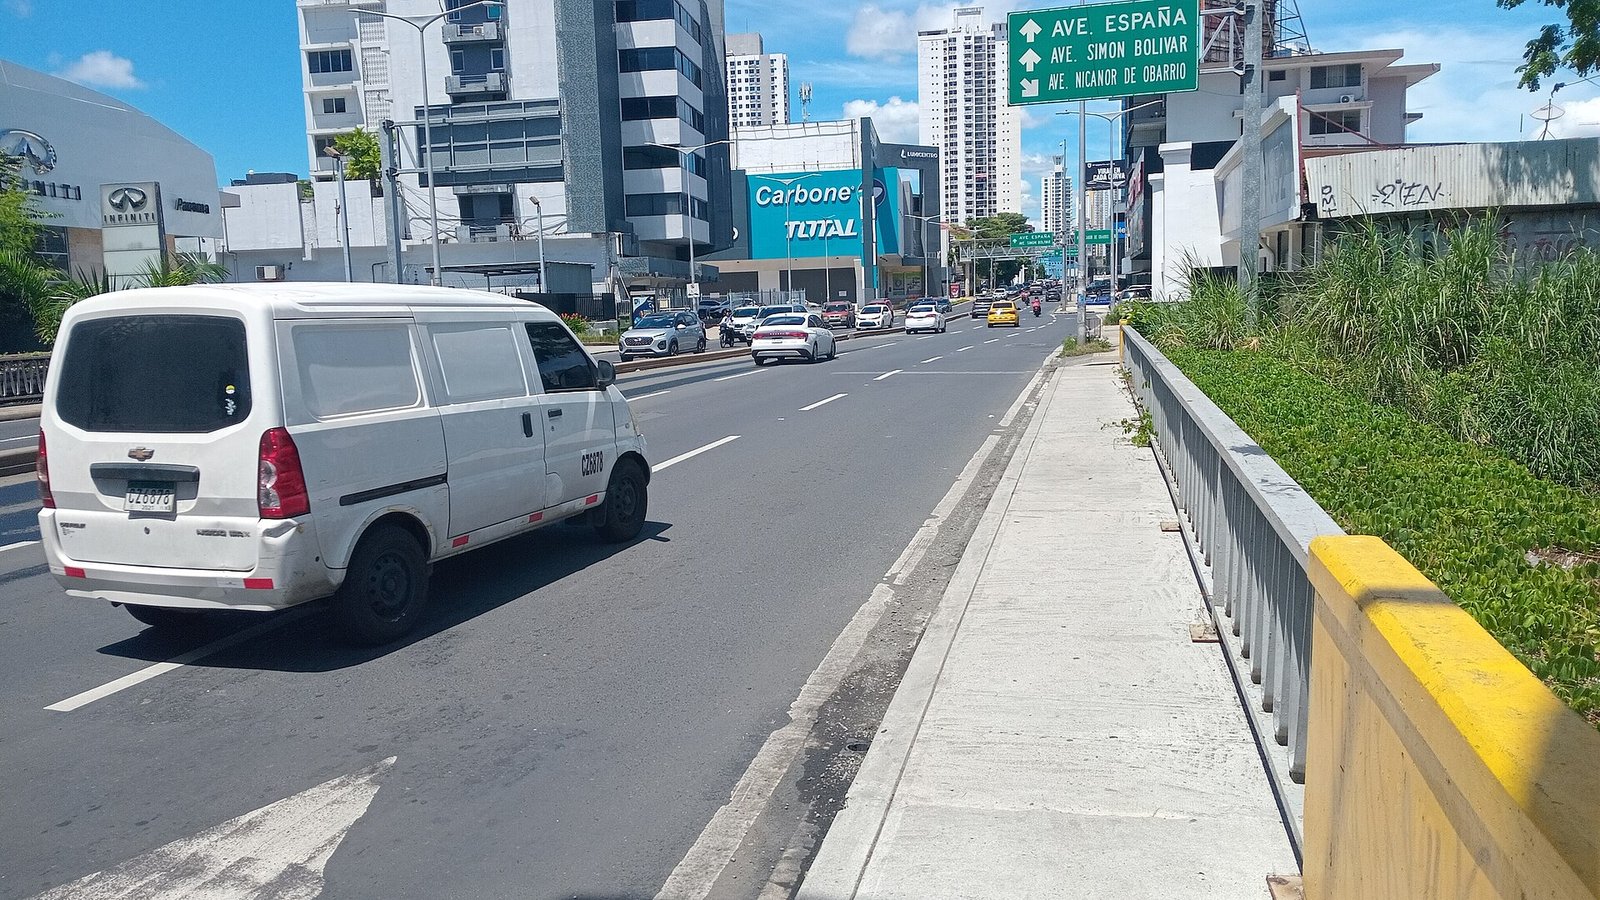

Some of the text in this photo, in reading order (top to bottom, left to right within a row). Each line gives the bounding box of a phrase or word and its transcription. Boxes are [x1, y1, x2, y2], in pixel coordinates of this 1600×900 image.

[1051, 6, 1187, 38] AVE. ESPAÑA
[1050, 35, 1188, 64] AVE. SIMON BOLIVAR
[1048, 62, 1186, 90] AVE. NICANOR DE OBARRIO
[756, 184, 851, 205] Carbone
[103, 212, 155, 224] INFINITI
[582, 450, 603, 477] CZ6878
[128, 488, 170, 505] CZ6878
